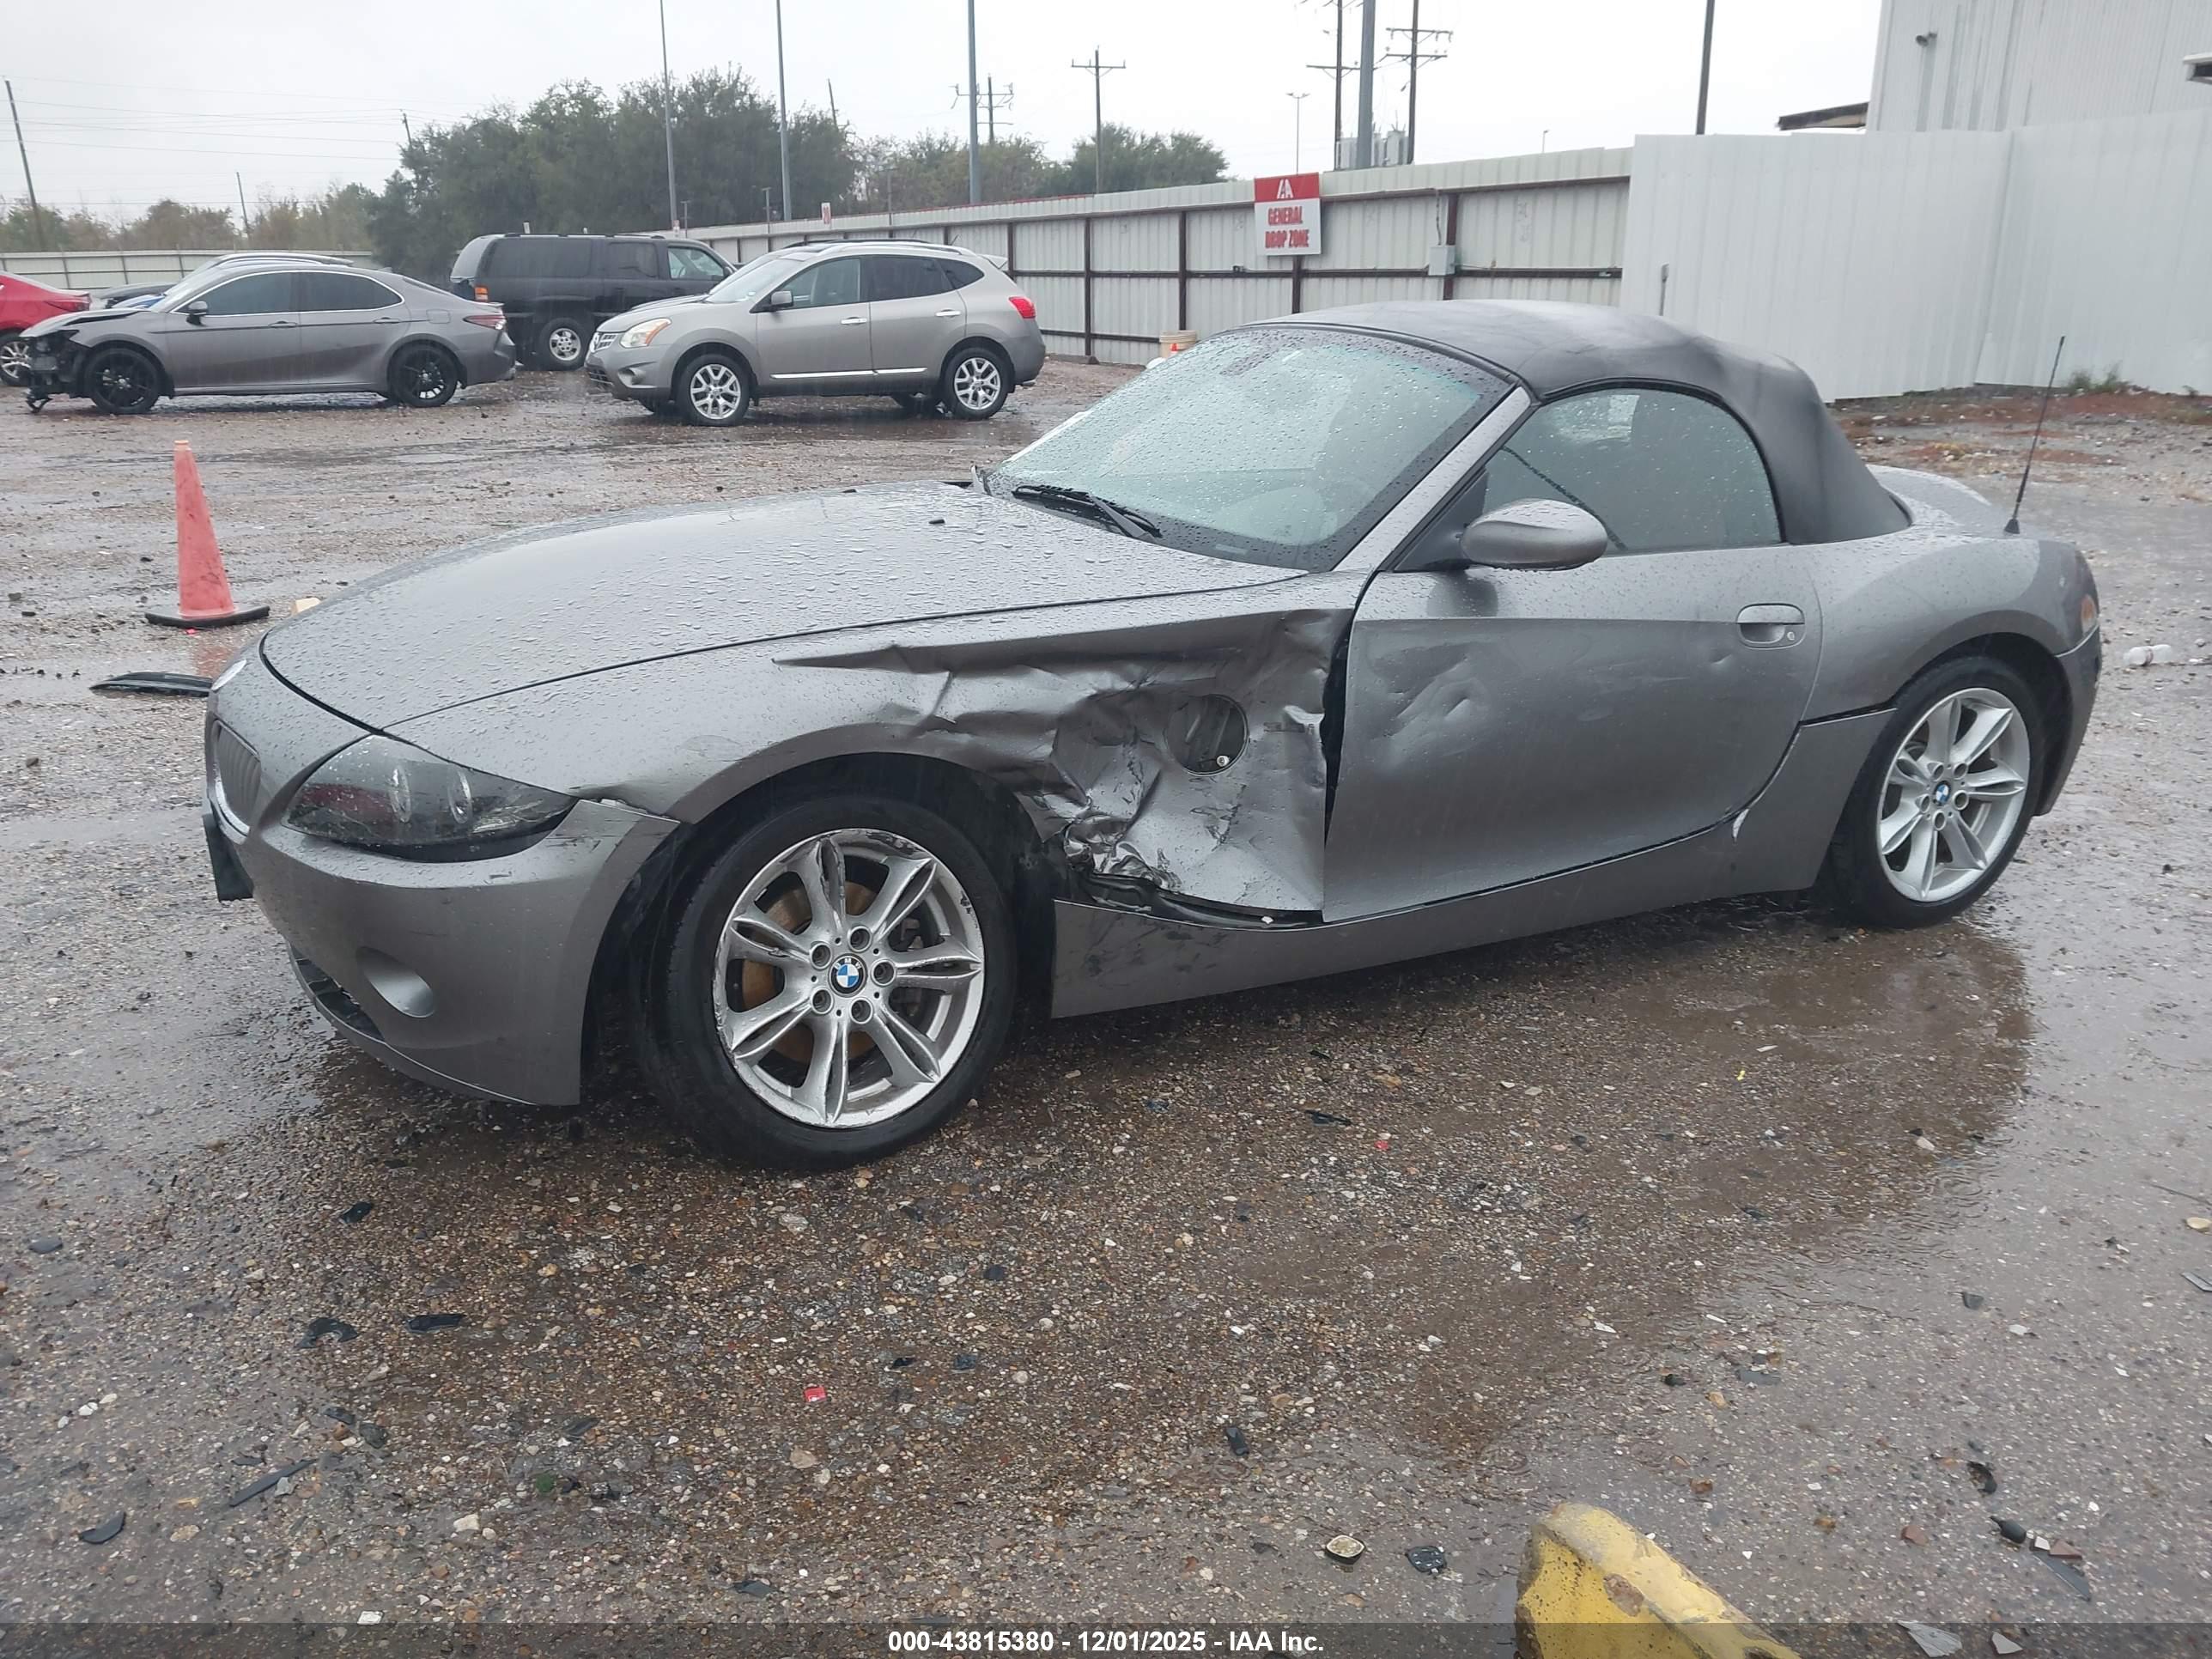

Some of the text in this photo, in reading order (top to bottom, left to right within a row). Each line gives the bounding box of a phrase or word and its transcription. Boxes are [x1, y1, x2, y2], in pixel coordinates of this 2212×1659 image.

[1268, 206, 1303, 226] GENERAL
[1265, 229, 1309, 248] DROP ZONE
[834, 957, 861, 969] BMW
